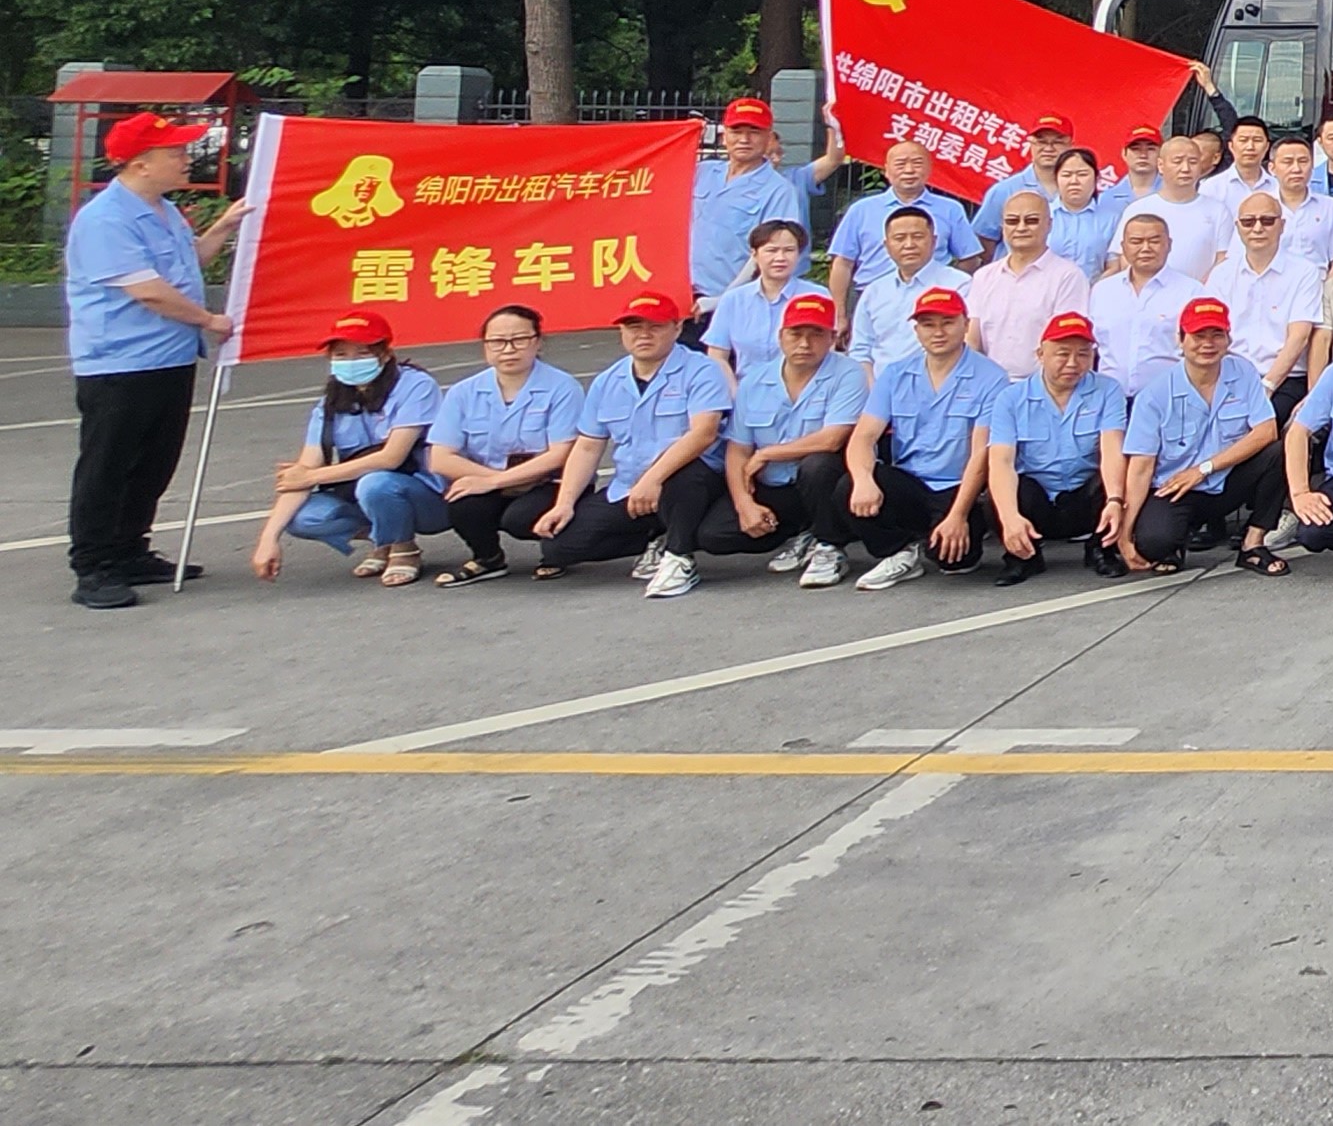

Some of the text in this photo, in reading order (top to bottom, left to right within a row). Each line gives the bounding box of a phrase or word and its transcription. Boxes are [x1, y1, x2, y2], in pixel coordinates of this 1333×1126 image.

[412, 167, 655, 206] 绵阳市出租汽车行业
[351, 235, 653, 304] 雷锋车队
